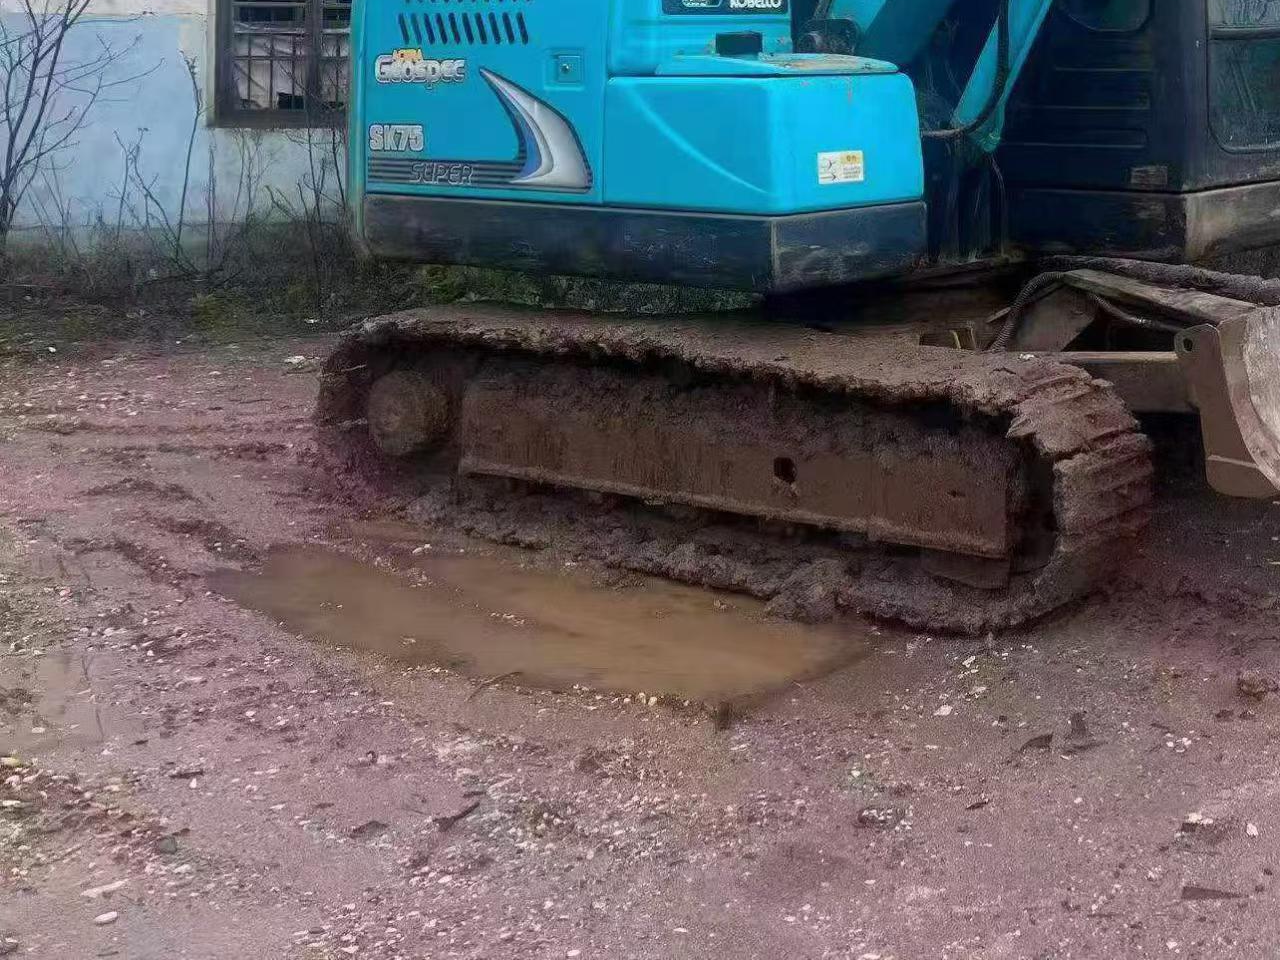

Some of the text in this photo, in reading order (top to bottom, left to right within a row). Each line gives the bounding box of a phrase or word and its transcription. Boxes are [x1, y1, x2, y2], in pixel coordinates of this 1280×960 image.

[375, 54, 465, 90] Geospec
[369, 124, 424, 152] SK75
[409, 161, 474, 185] SUPER
